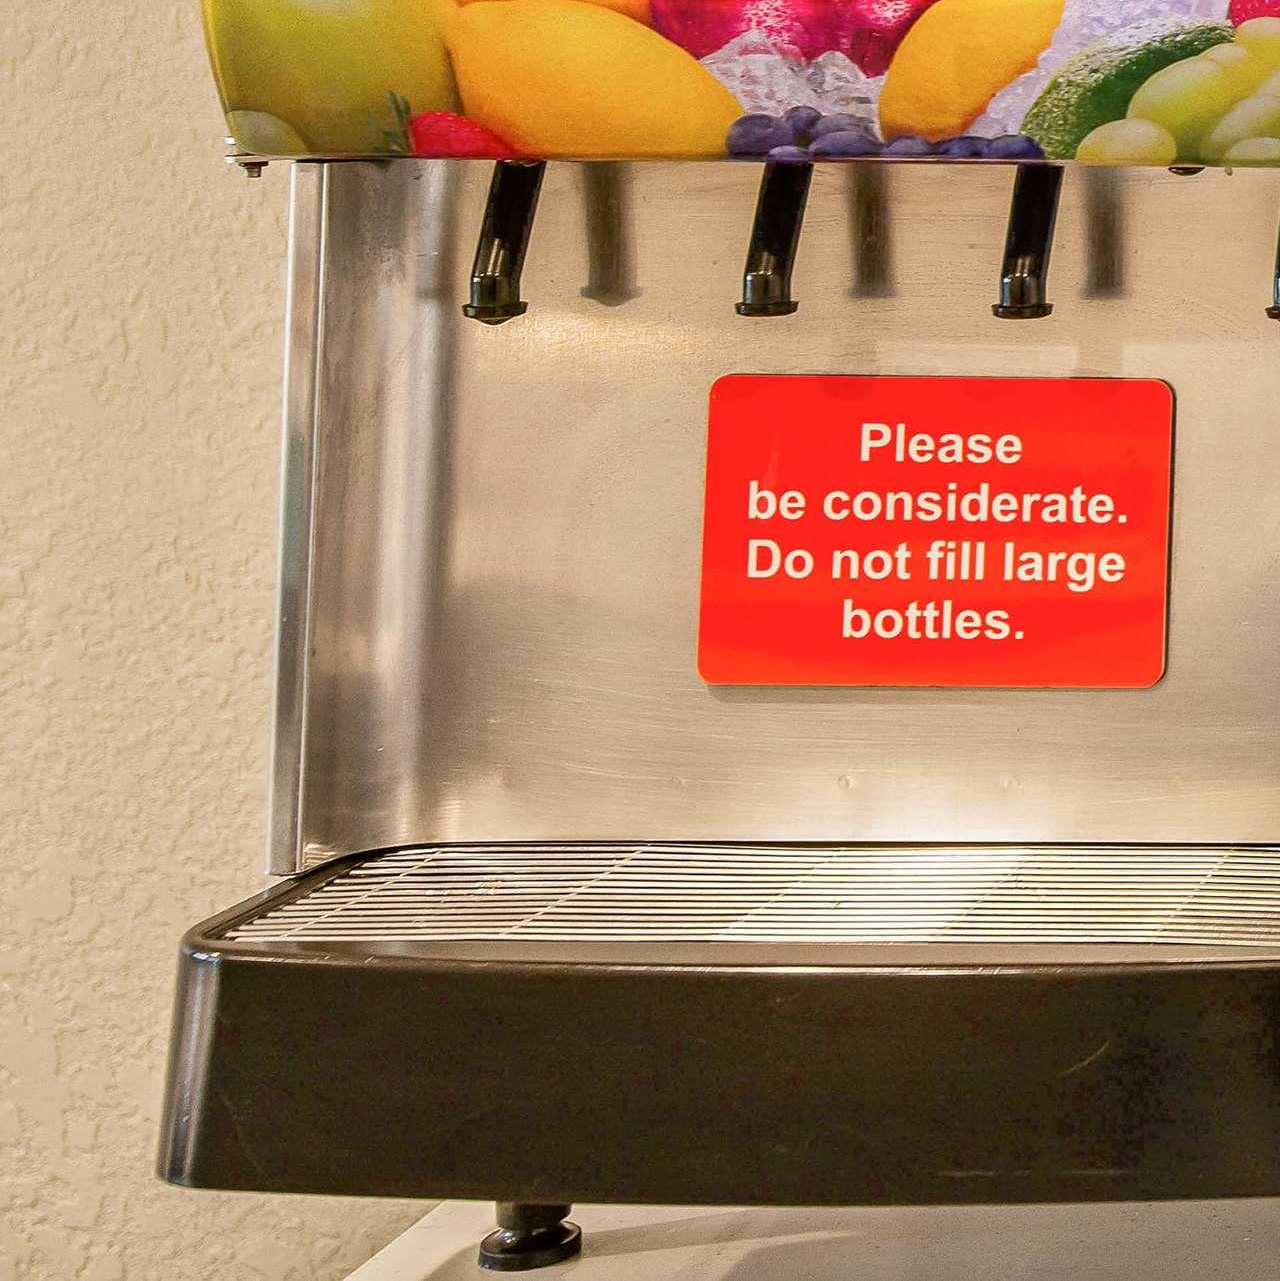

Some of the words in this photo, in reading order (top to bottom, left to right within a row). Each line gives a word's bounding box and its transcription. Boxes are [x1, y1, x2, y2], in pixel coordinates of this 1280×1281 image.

[859, 422, 1023, 464] Please
[747, 480, 806, 520] be
[822, 482, 1128, 524] considerate.
[745, 539, 814, 579] Do
[831, 544, 912, 580] not
[926, 541, 986, 581] fill
[1003, 542, 1126, 592] large
[841, 599, 1025, 641] bottles.
